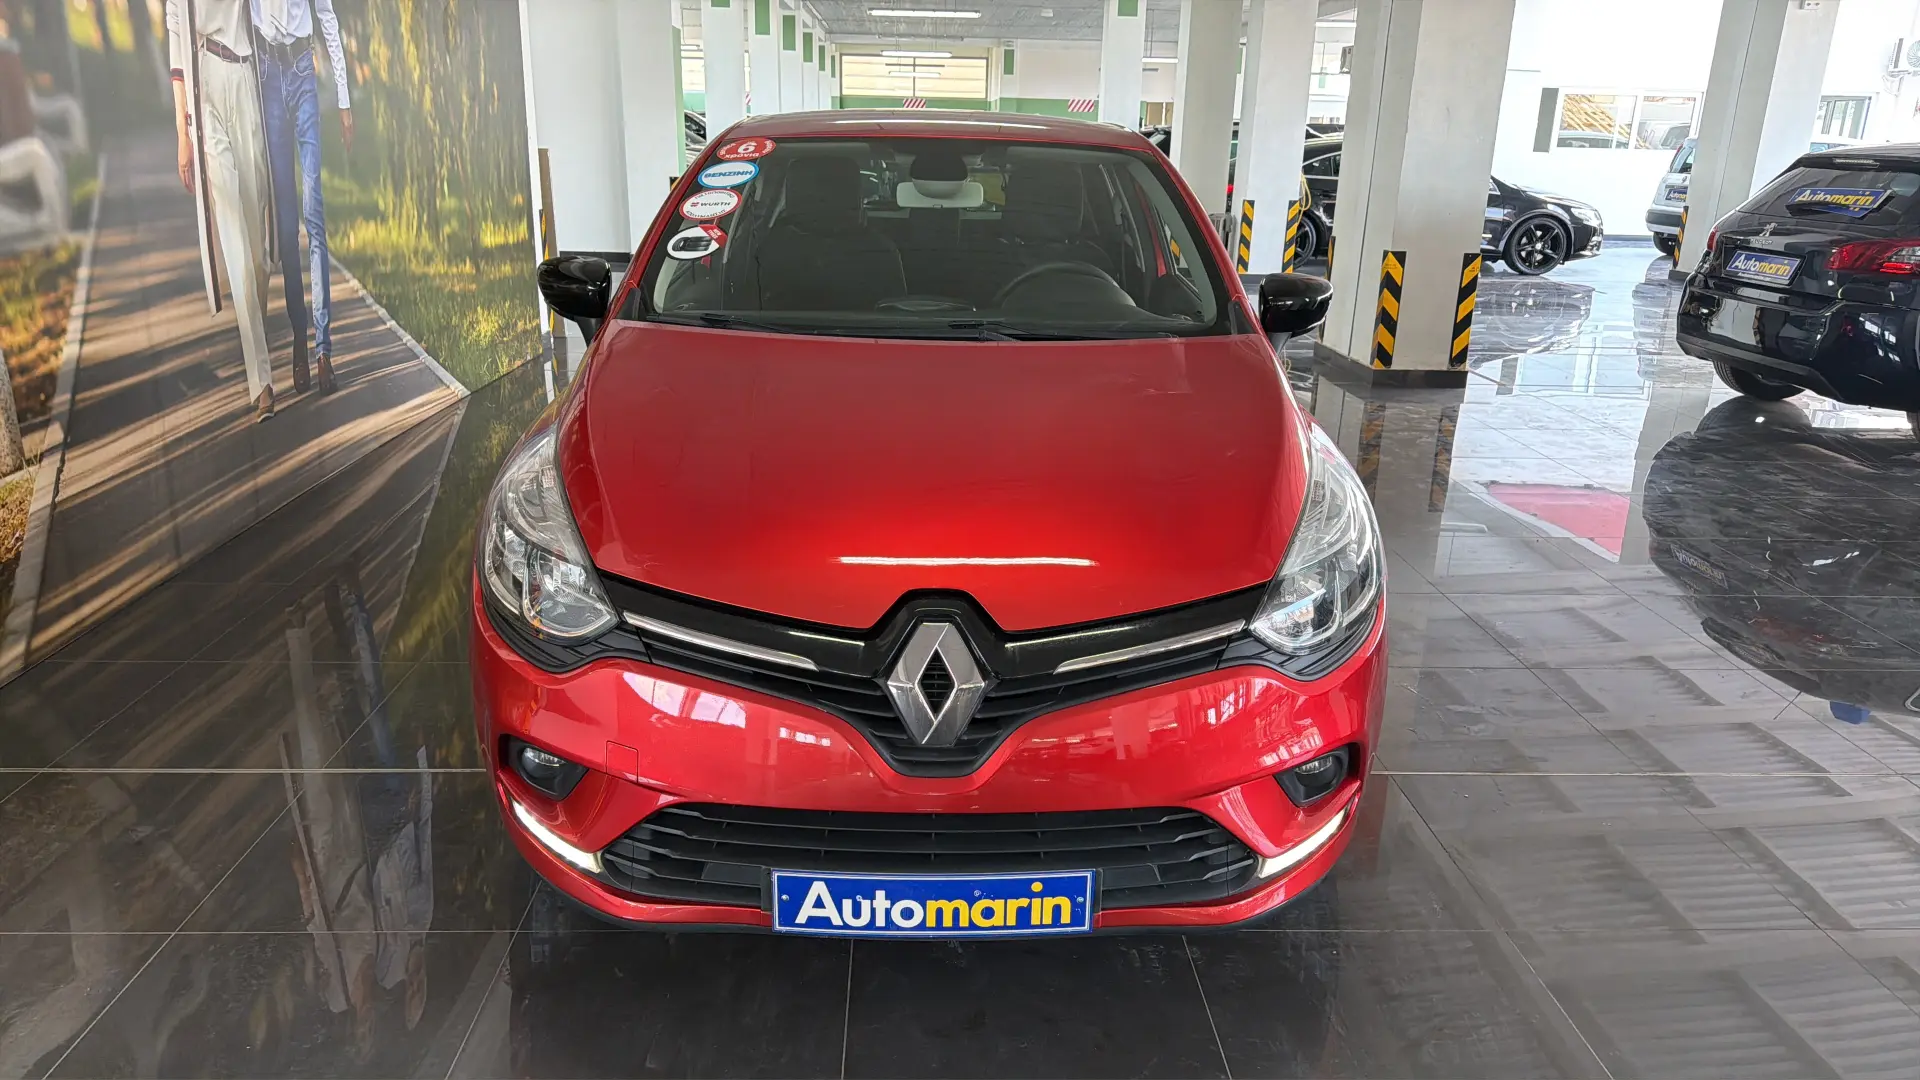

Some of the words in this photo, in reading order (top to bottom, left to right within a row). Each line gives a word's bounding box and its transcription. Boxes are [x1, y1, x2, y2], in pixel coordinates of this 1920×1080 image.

[737, 141, 757, 153] 6
[1795, 190, 1875, 206] Automarin
[1732, 253, 1791, 276] Automarin
[795, 880, 1071, 928] Automarin
